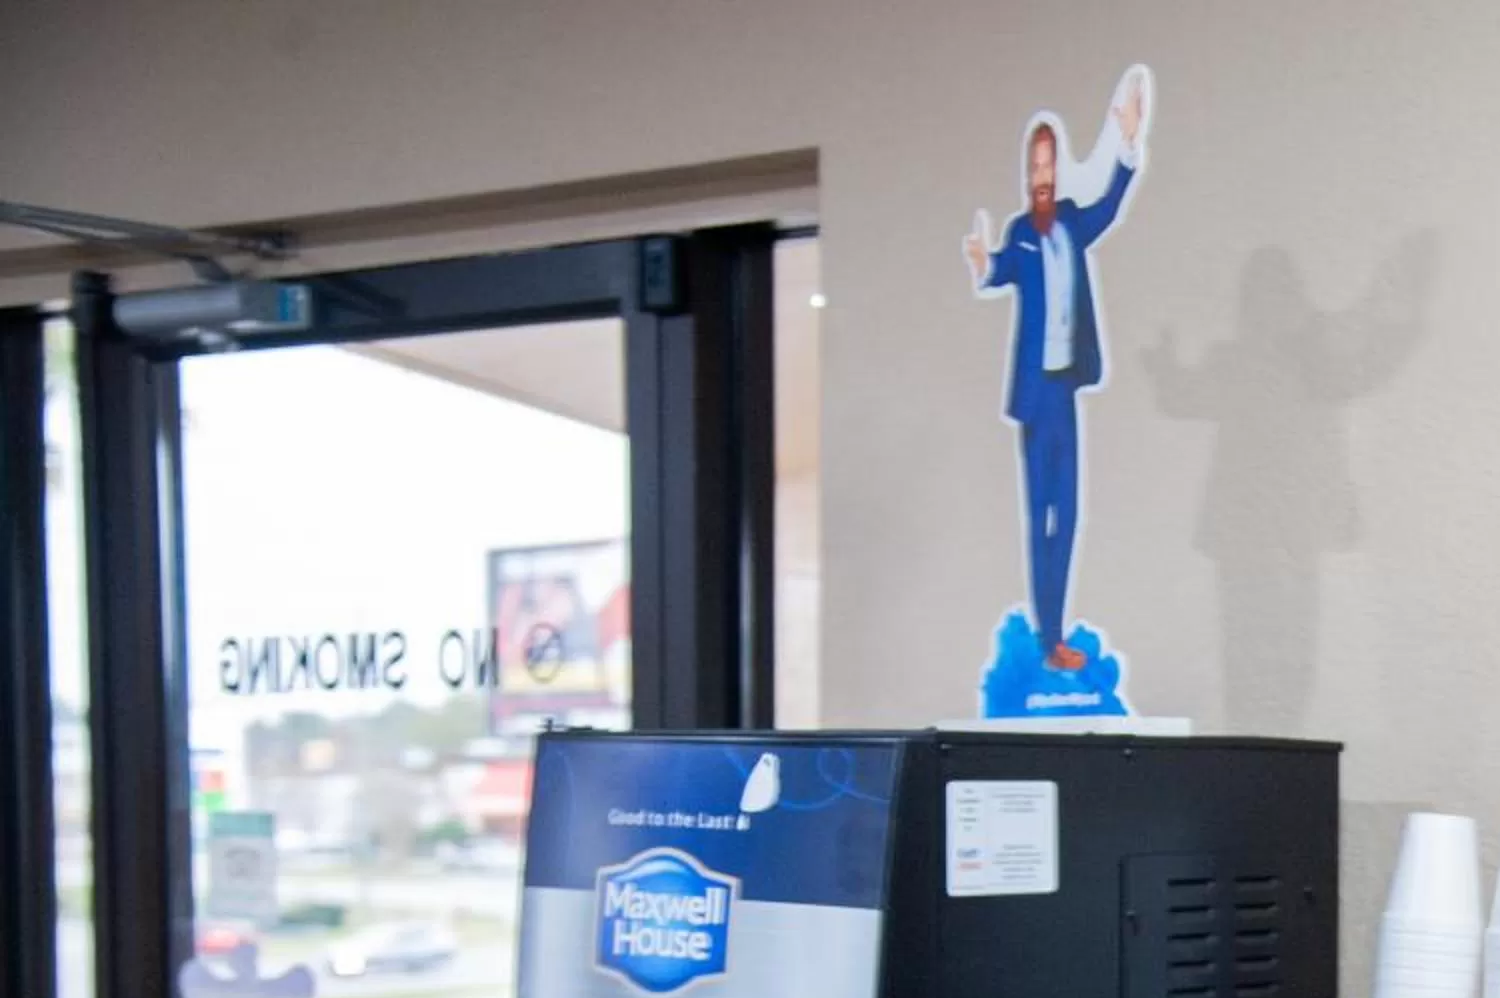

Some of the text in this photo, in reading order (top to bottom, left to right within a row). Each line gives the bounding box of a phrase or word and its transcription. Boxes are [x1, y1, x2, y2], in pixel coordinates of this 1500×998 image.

[667, 809, 696, 828] the
[697, 811, 736, 831] Last
[604, 880, 728, 926] Maxwell
[612, 918, 714, 960] House
